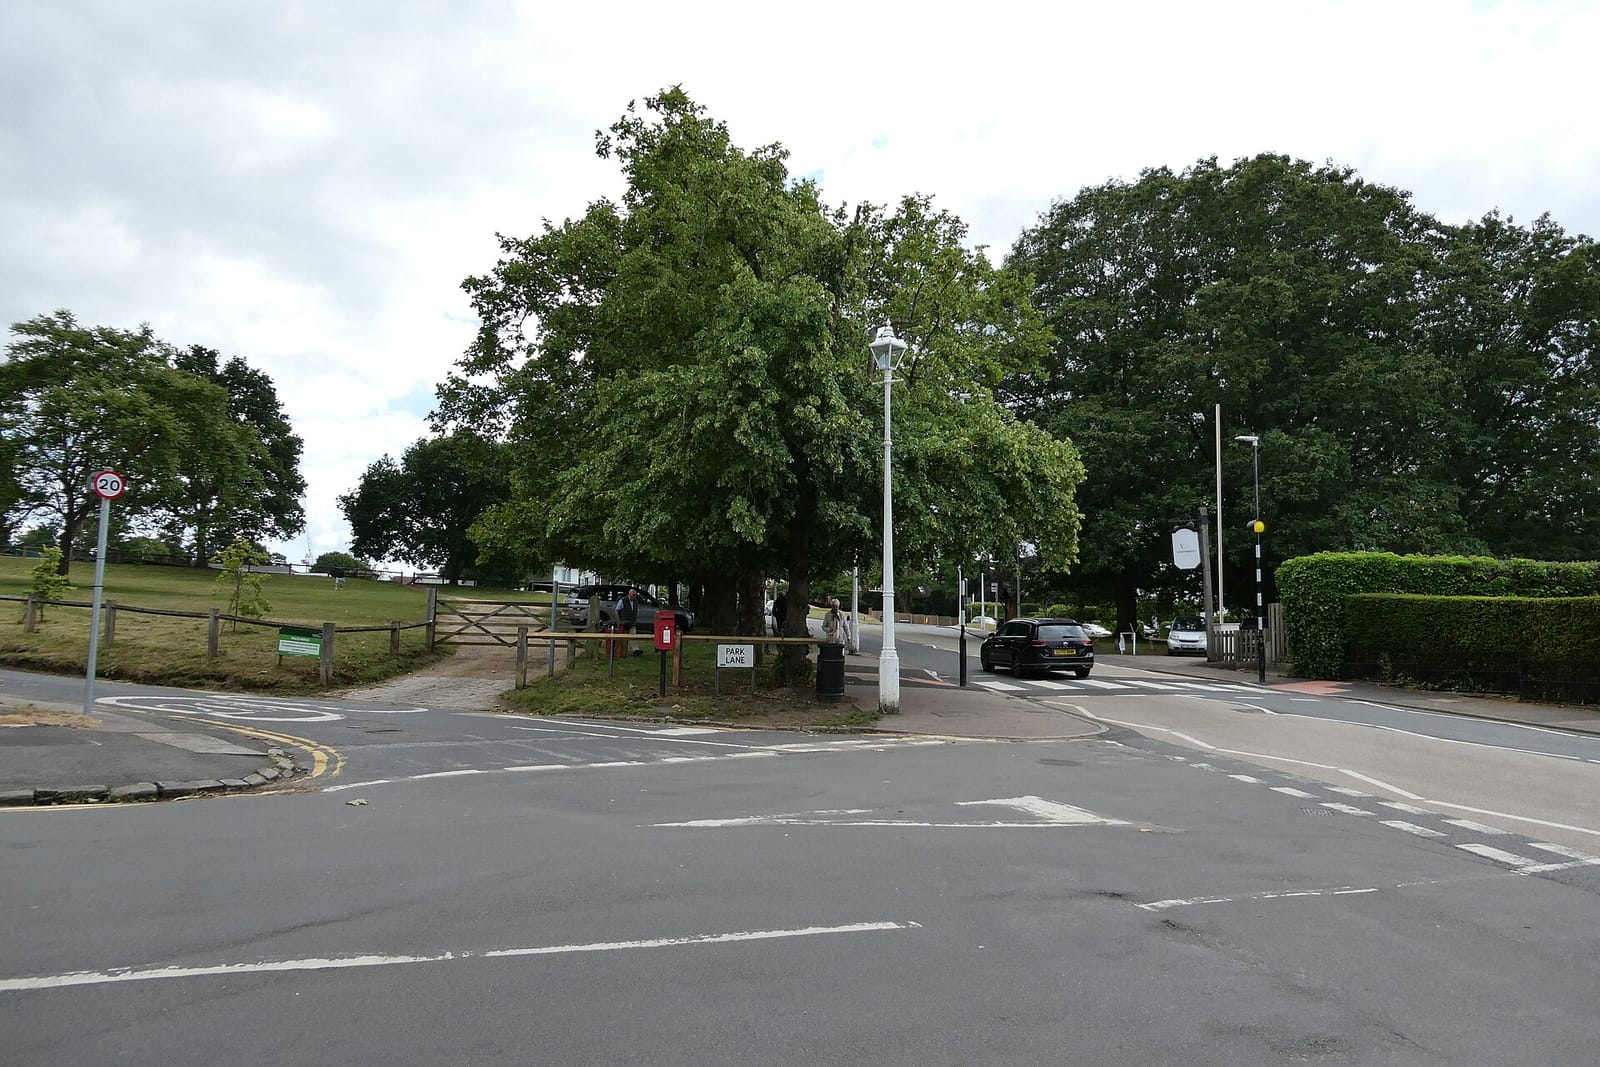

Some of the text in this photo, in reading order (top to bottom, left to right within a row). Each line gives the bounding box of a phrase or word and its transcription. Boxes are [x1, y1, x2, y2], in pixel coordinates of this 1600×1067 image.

[99, 478, 120, 491] 20
[725, 647, 745, 655] PARK
[725, 656, 745, 664] LANE
